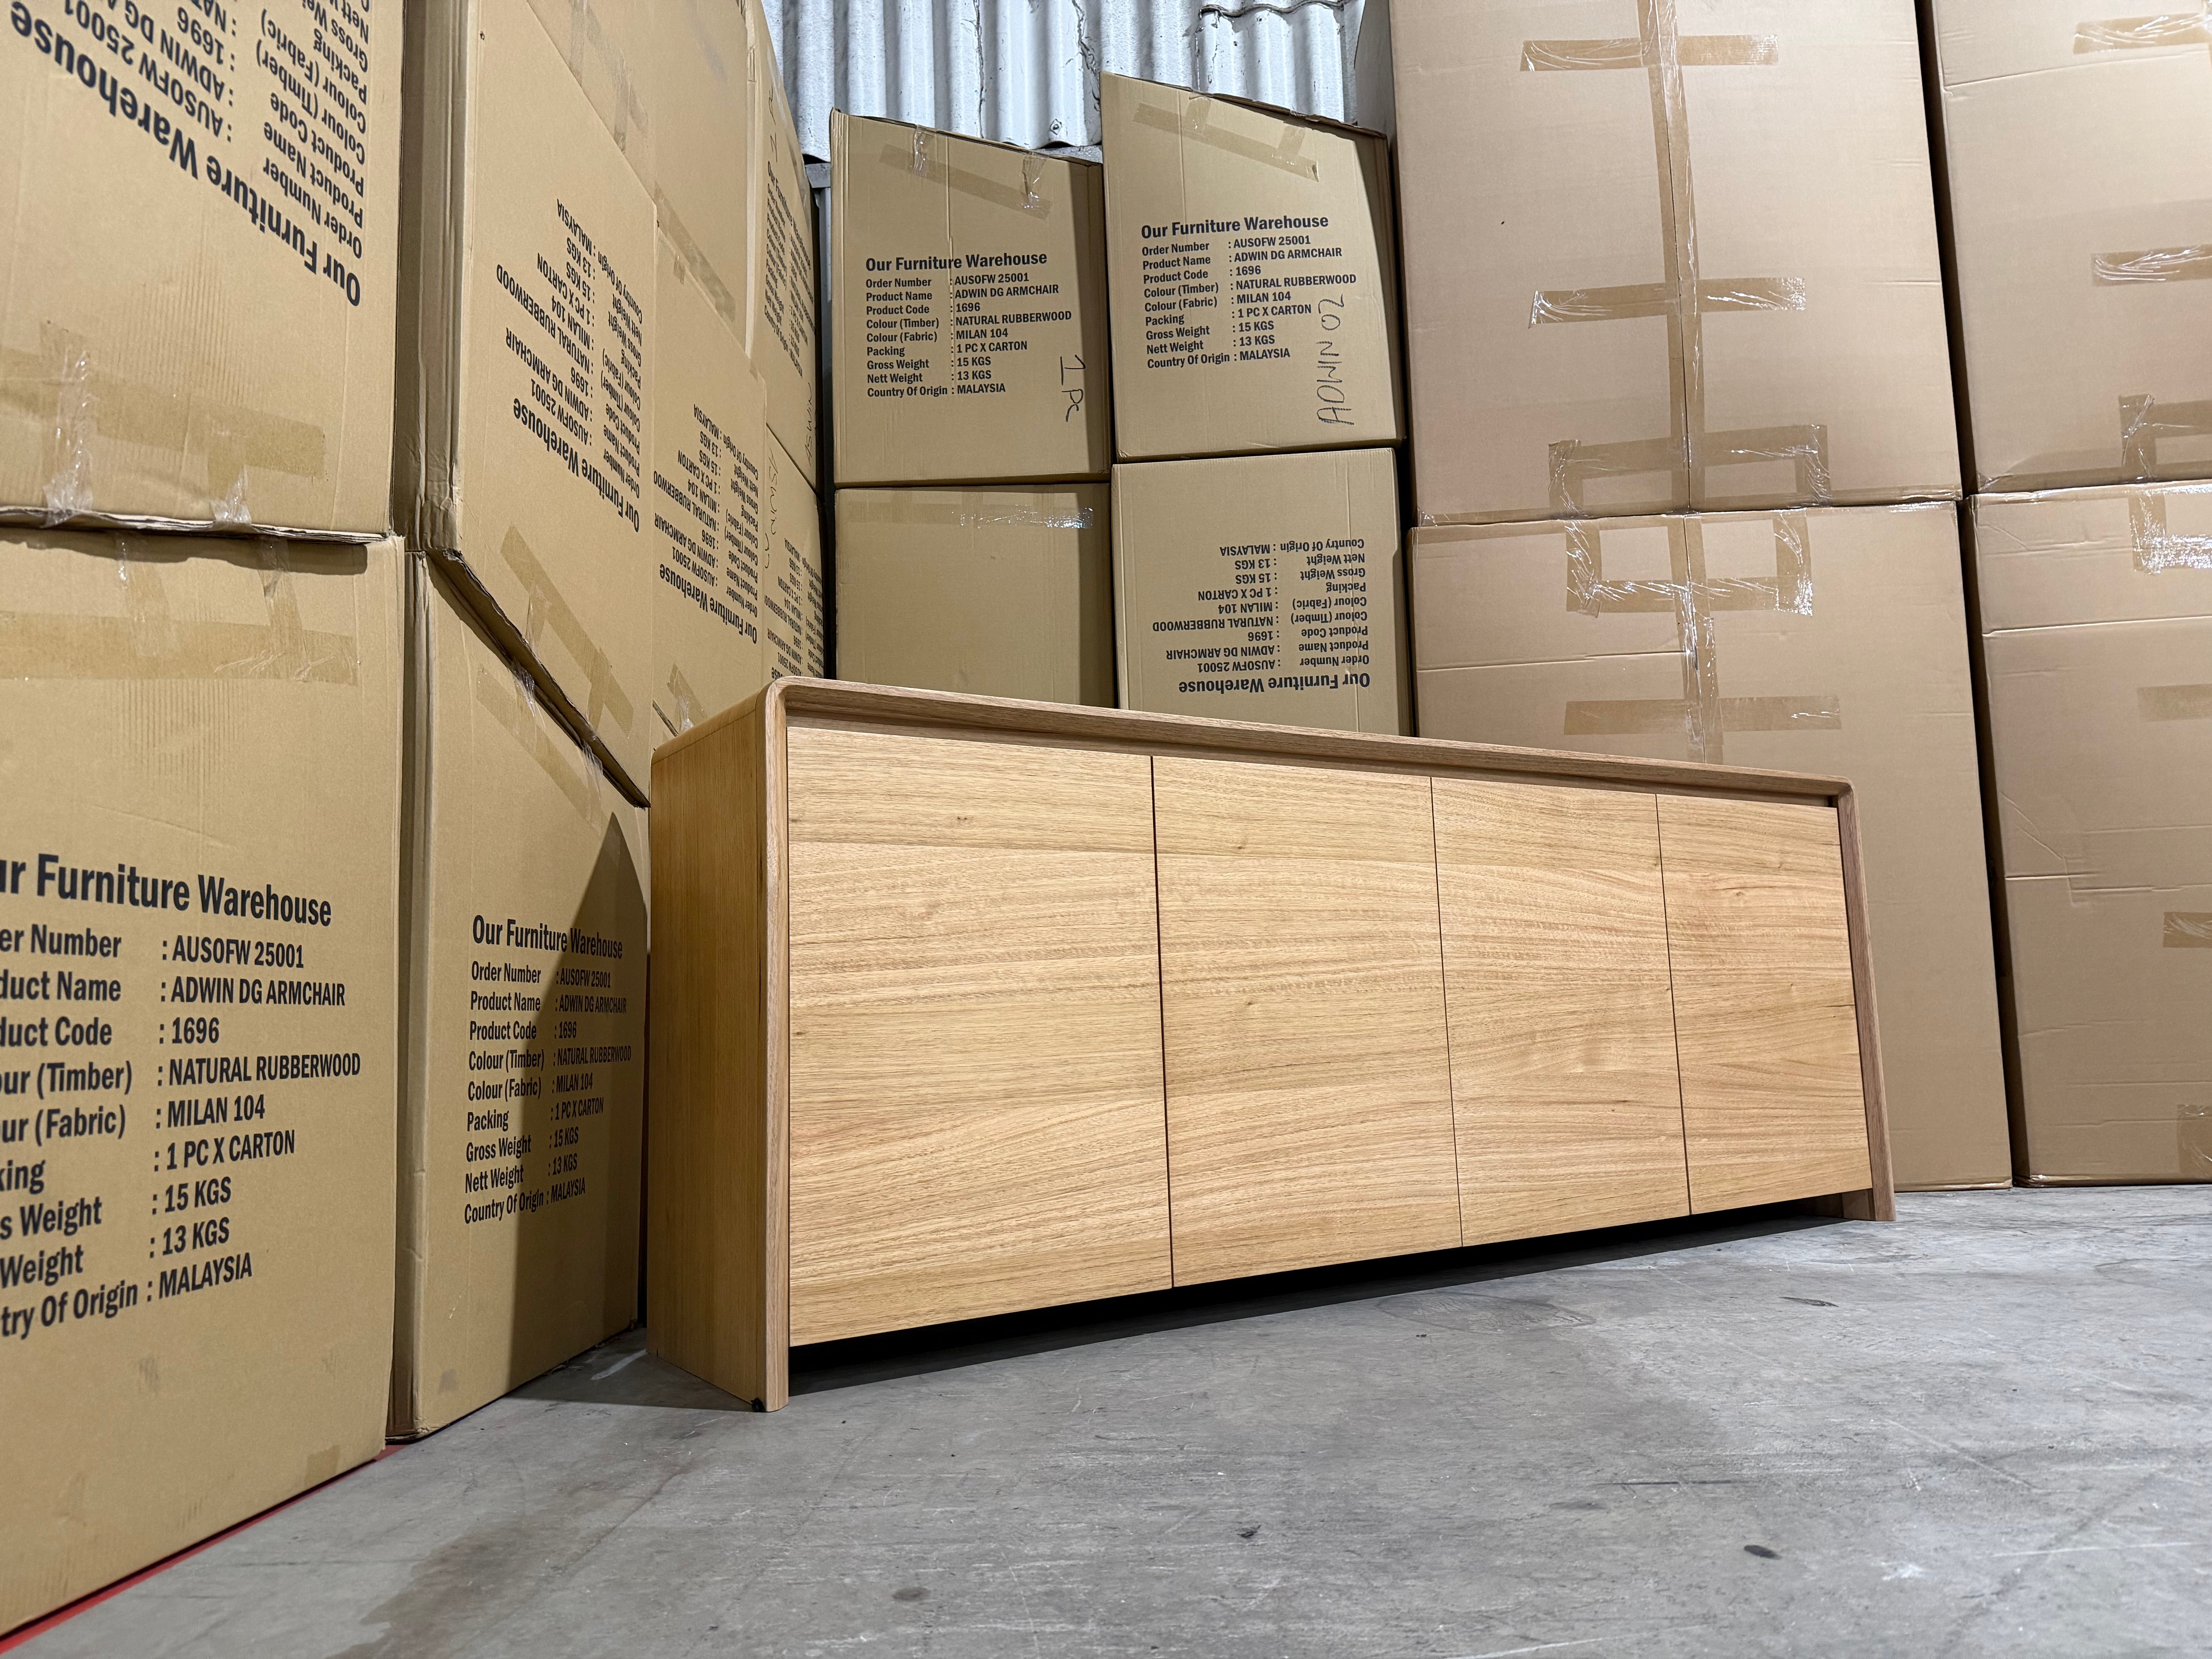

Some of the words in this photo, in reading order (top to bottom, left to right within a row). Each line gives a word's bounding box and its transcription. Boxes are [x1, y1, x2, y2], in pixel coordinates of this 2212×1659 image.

[64, 0, 134, 65] 25001
[125, 0, 154, 44] DG
[177, 6, 224, 65] 1696
[160, 29, 225, 101] ADWIN
[256, 39, 318, 120] (Timber)
[313, 28, 367, 105] Packing
[10, 0, 198, 180] Warehouse
[138, 52, 223, 137] AUSOFW
[270, 92, 307, 143] Code
[263, 122, 306, 179] Name
[321, 108, 365, 165] Colour
[311, 129, 364, 198] Product
[263, 157, 321, 225] Number
[309, 162, 363, 229] Product
[206, 155, 317, 275] Furniture
[556, 198, 592, 256] MALAYSIA
[1141, 225, 1168, 239] Our
[1171, 219, 1240, 235] Furniture
[1243, 215, 1328, 230] Warehouse
[324, 211, 362, 259] Order
[1142, 245, 1169, 256] Order
[1171, 241, 1209, 253] Number
[1233, 236, 1276, 248] AUSOFW
[1278, 235, 1311, 246] 25001
[598, 251, 615, 286] Origin
[866, 258, 892, 271] Our
[896, 256, 962, 270] Furniture
[965, 252, 1047, 268] Warehouse
[1142, 257, 1181, 270] Product
[1183, 256, 1211, 266] Name
[1234, 251, 1268, 262] ADWIN
[1270, 250, 1285, 259] DG
[1287, 247, 1342, 259] ARMCHAIR
[323, 252, 360, 306] Our
[615, 276, 622, 296] Of
[866, 278, 892, 288] Order
[894, 277, 932, 287] Number
[954, 274, 996, 285] AUSOFW
[998, 272, 1029, 283] 25001
[866, 291, 903, 301] Product
[905, 291, 932, 301] Name
[955, 288, 988, 299] ADWIN
[990, 287, 1004, 297] DG
[1005, 284, 1059, 296] ARMCHAIR
[1144, 287, 1176, 298] Colour
[1178, 282, 1219, 297] (Timber)
[1236, 278, 1282, 290] NATURAL
[1284, 274, 1356, 287] RUBBERWOOD
[496, 264, 555, 339] RUBBERWOOD
[622, 283, 642, 324] Country
[866, 319, 898, 329] Colour
[899, 317, 939, 330] (Timber)
[955, 314, 1000, 326] NATURAL
[1001, 311, 1072, 324] RUBBERWOOD
[557, 326, 589, 374] NATURAL
[1147, 357, 1185, 368] Country
[1187, 354, 1199, 365] Of
[1200, 352, 1230, 365] Origin
[1239, 347, 1290, 361] MALAYSIA
[531, 378, 556, 416] 25001
[601, 369, 623, 412] (Timber)
[867, 387, 904, 398] Country
[906, 386, 917, 396] Of
[919, 385, 947, 397] Origin
[957, 383, 1006, 394] MALAYSIA
[557, 404, 588, 445] AUSOFW
[623, 402, 640, 433] Colour
[694, 404, 719, 440] MALAYSIA
[513, 398, 579, 477] Warehouse
[723, 434, 736, 457] Origin
[603, 448, 625, 484] Number
[736, 449, 742, 464] Of
[742, 453, 758, 481] Country
[581, 458, 623, 518] Furniture
[625, 472, 639, 499] Order
[687, 478, 698, 498] 104
[699, 488, 717, 514] MILAN
[625, 500, 639, 532] Our
[725, 508, 744, 537] (Fabric)
[701, 529, 715, 550] 1696
[744, 527, 758, 549] Colour
[1219, 544, 1270, 556] MALAYSIA
[1280, 540, 1309, 553] Origin
[1312, 541, 1323, 551] Of
[1325, 538, 1364, 549] Country
[728, 550, 740, 569] Code
[740, 560, 758, 584] Product
[659, 563, 708, 613] Warehouse
[709, 597, 743, 636] Furniture
[1152, 618, 1225, 632] RUBBERWOOD
[1227, 616, 1273, 628] NATURAL
[1290, 611, 1332, 625] (Timber)
[1334, 611, 1367, 621] Colour
[744, 621, 757, 644] Our
[1329, 640, 1369, 650] Product
[1166, 647, 1221, 659] ARMCHAIR
[1223, 647, 1238, 657] DG
[1240, 645, 1275, 656] ADWIN
[1298, 642, 1327, 653] Name
[1178, 678, 1264, 694] Warehouse
[1267, 674, 1338, 690] Furniture
[1342, 672, 1370, 687] Our
[37, 853, 190, 911] Furniture
[198, 874, 331, 927] Warehouse
[31, 923, 122, 958] Number
[172, 934, 251, 965] AUSOFW
[254, 941, 304, 968] 25001
[472, 914, 503, 945] Our
[506, 918, 567, 952] Furniture
[570, 927, 622, 959] Warehouse
[470, 990, 512, 1011] Product
[514, 992, 540, 1011] Name
[558, 992, 583, 1012] ADWIN
[584, 995, 594, 1013] DG
[594, 996, 627, 1013] ARMCHAIR
[55, 1016, 112, 1046] Code
[172, 1017, 219, 1044] 1696
[469, 1050, 504, 1070] Colour
[505, 1049, 544, 1073] (Timber)
[557, 1047, 589, 1066] NATURAL
[589, 1045, 631, 1064] RUBBERWOOD
[36, 1060, 132, 1100] (Timber)
[169, 1056, 252, 1085] NATURAL
[256, 1053, 360, 1080] RUBBERWOOD
[167, 1142, 177, 1170] 1
[183, 1139, 209, 1168] PC
[212, 1137, 225, 1164] X
[228, 1129, 294, 1161] CARTON
[466, 1142, 496, 1162] Gross
[498, 1134, 531, 1159] Weight
[553, 1128, 563, 1148] 15
[564, 1126, 579, 1146] KGS
[41, 1291, 68, 1327] Of
[73, 1279, 138, 1319] Origin
[158, 1252, 252, 1299] MALAYSIA
